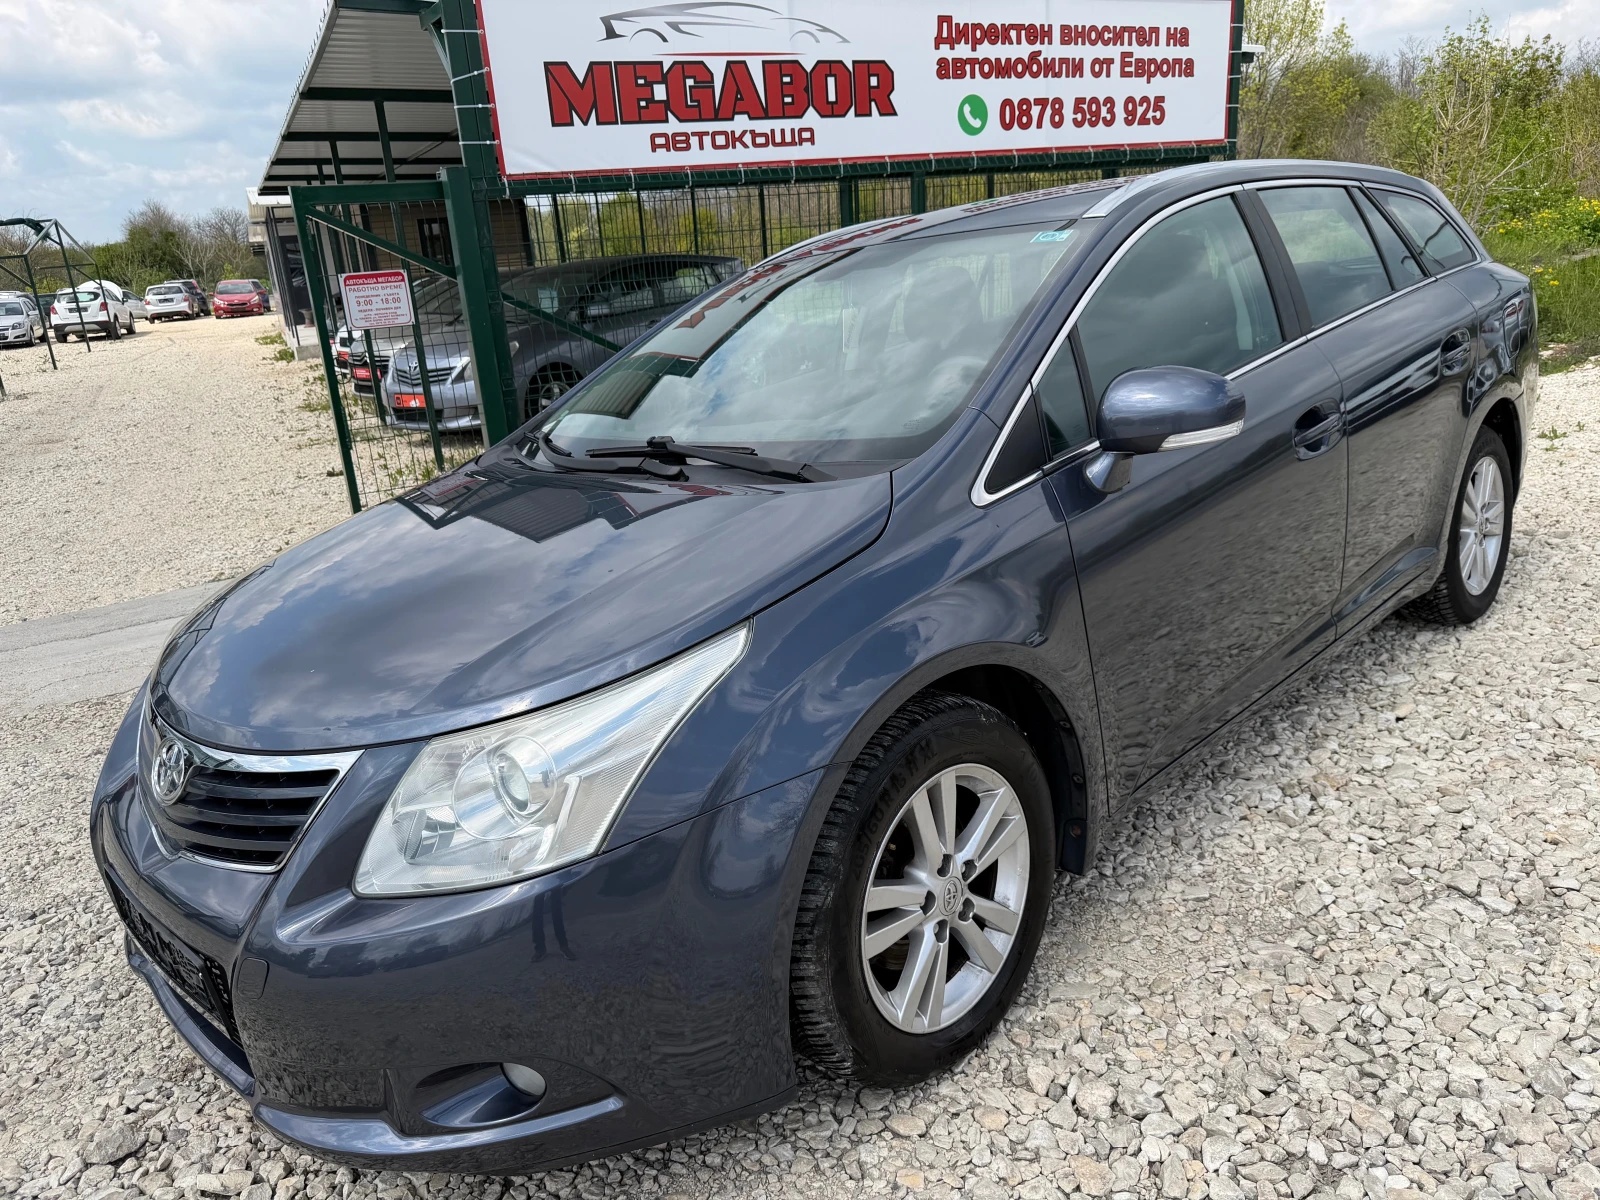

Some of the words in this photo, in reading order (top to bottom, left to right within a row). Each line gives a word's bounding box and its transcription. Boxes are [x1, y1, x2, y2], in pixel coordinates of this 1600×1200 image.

[934, 15, 1052, 51] Директен
[1060, 24, 1160, 46] вносител
[1166, 27, 1189, 47] на
[936, 50, 1084, 79] автомобили
[1090, 57, 1114, 78] от
[1120, 52, 1194, 84] Европа
[543, 59, 898, 127] MEGABOR
[999, 97, 1064, 131] 0878
[1072, 96, 1116, 128] 593
[1123, 95, 1165, 126] 925
[650, 127, 815, 153] АВТОКЪЩА
[348, 285, 379, 293] РАБОТНО
[356, 299, 373, 307] 9:00
[381, 297, 401, 305] 18:00
